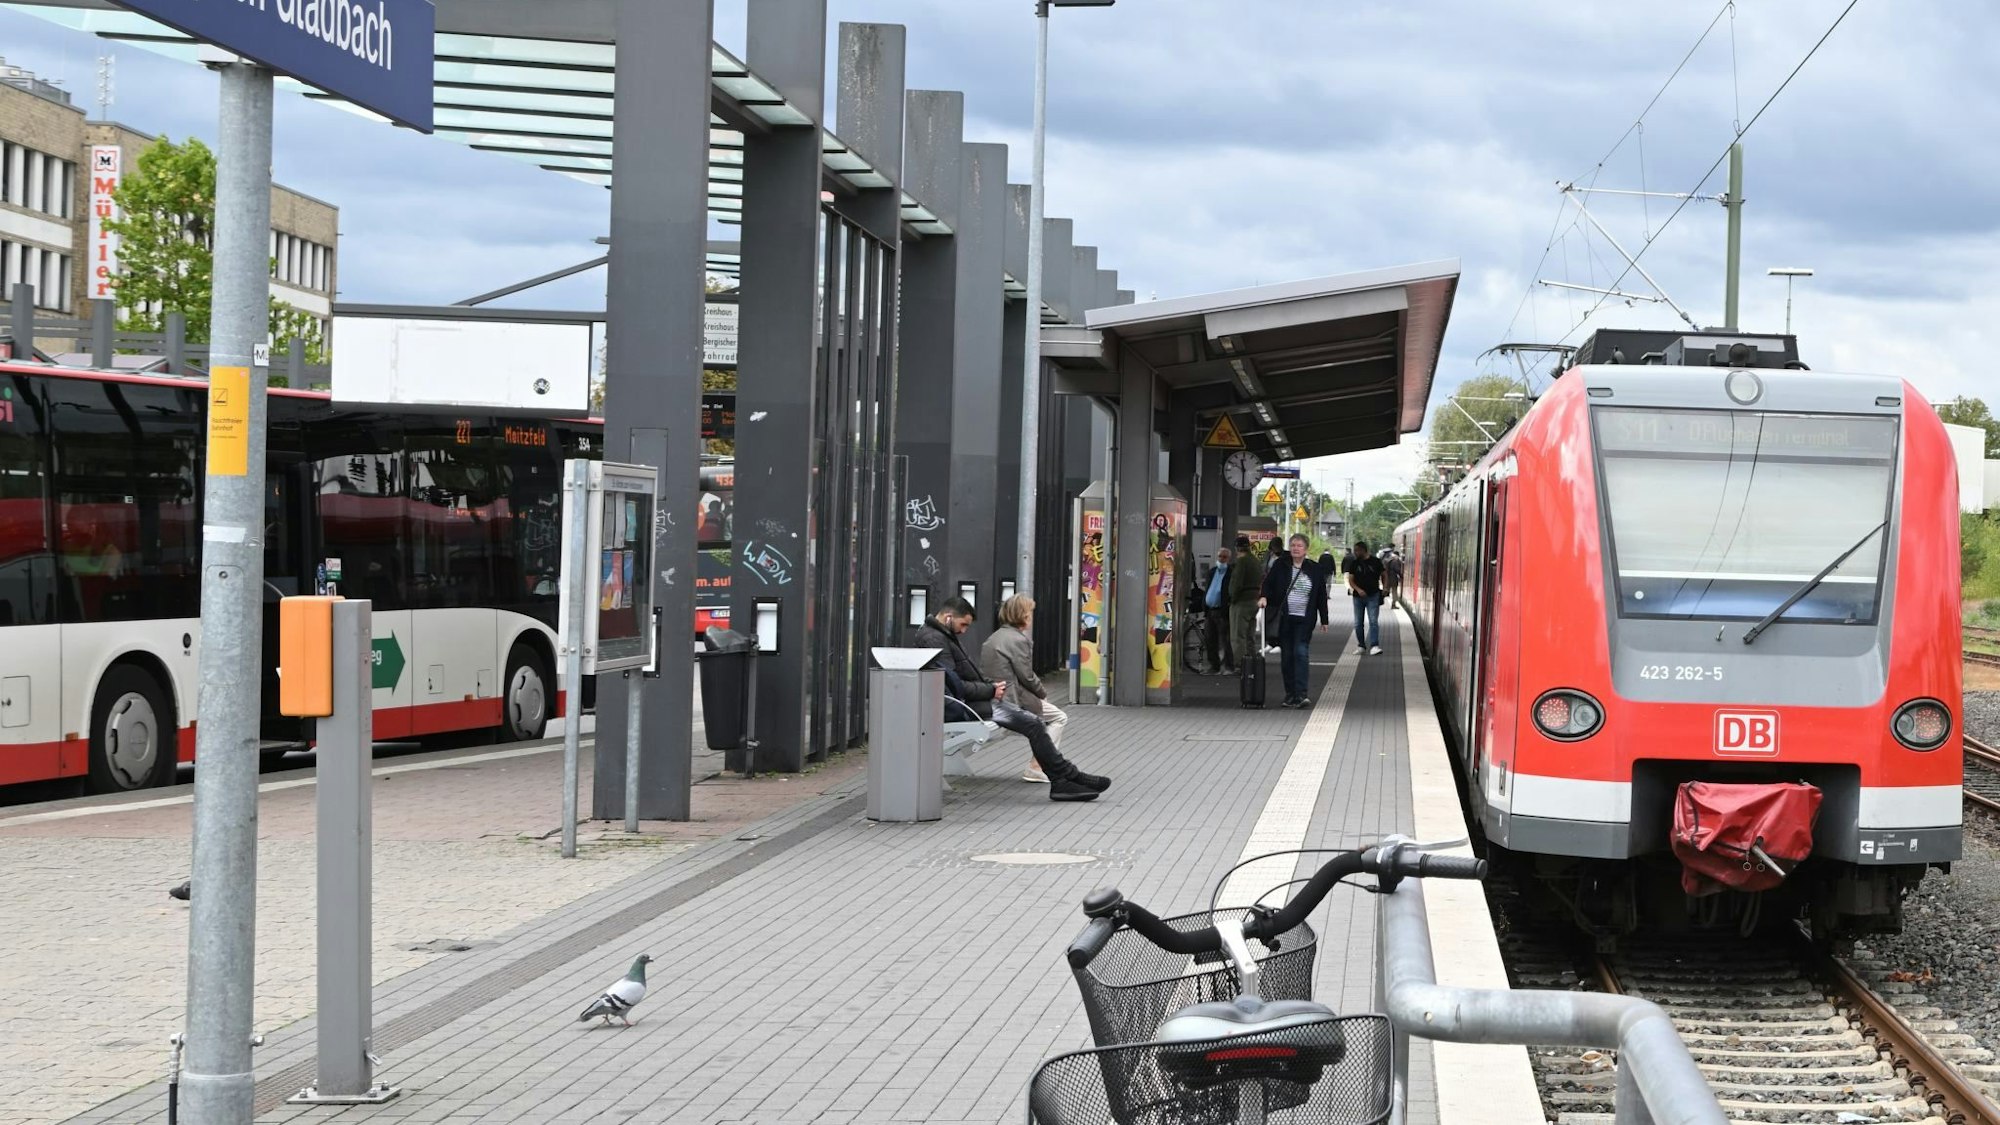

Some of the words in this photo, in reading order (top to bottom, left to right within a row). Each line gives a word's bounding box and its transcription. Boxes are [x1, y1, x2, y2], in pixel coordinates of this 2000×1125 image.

[505, 426, 546, 446] Moitzfeld
[1640, 665, 1669, 679] 423
[1675, 666, 1723, 681] 262-5
[1723, 717, 1772, 748] DB
